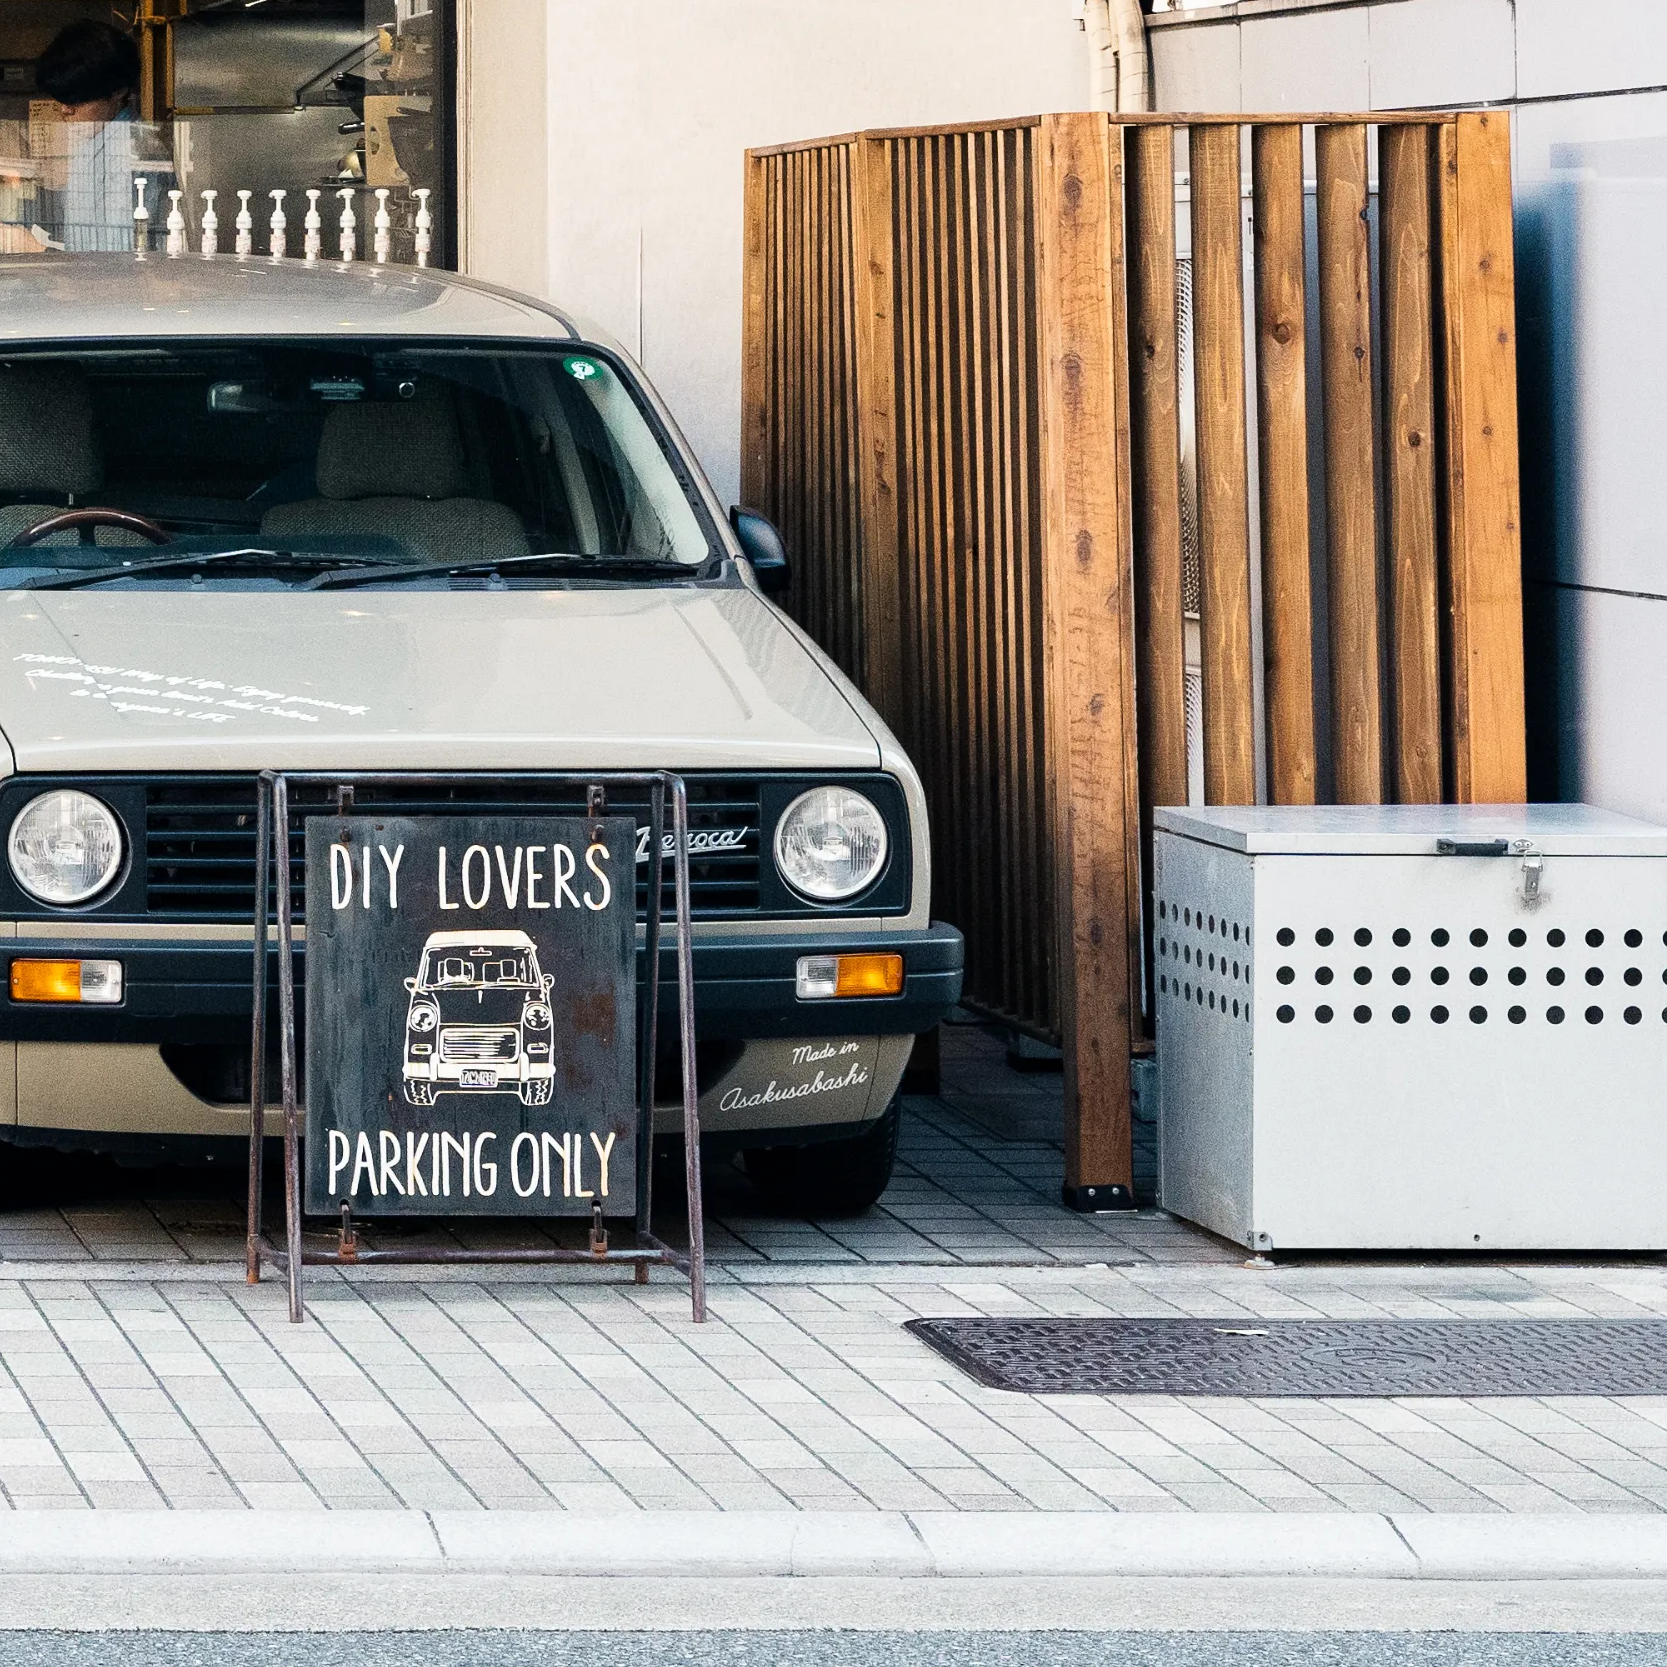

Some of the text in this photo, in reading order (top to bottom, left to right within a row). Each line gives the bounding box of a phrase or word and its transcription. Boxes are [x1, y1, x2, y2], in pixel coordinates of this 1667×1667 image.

[330, 844, 611, 911] DIY LOVERS
[792, 1040, 859, 1065] Made in
[720, 1063, 868, 1111] Asakusabashi
[327, 1130, 616, 1198] PARKING ONLY
